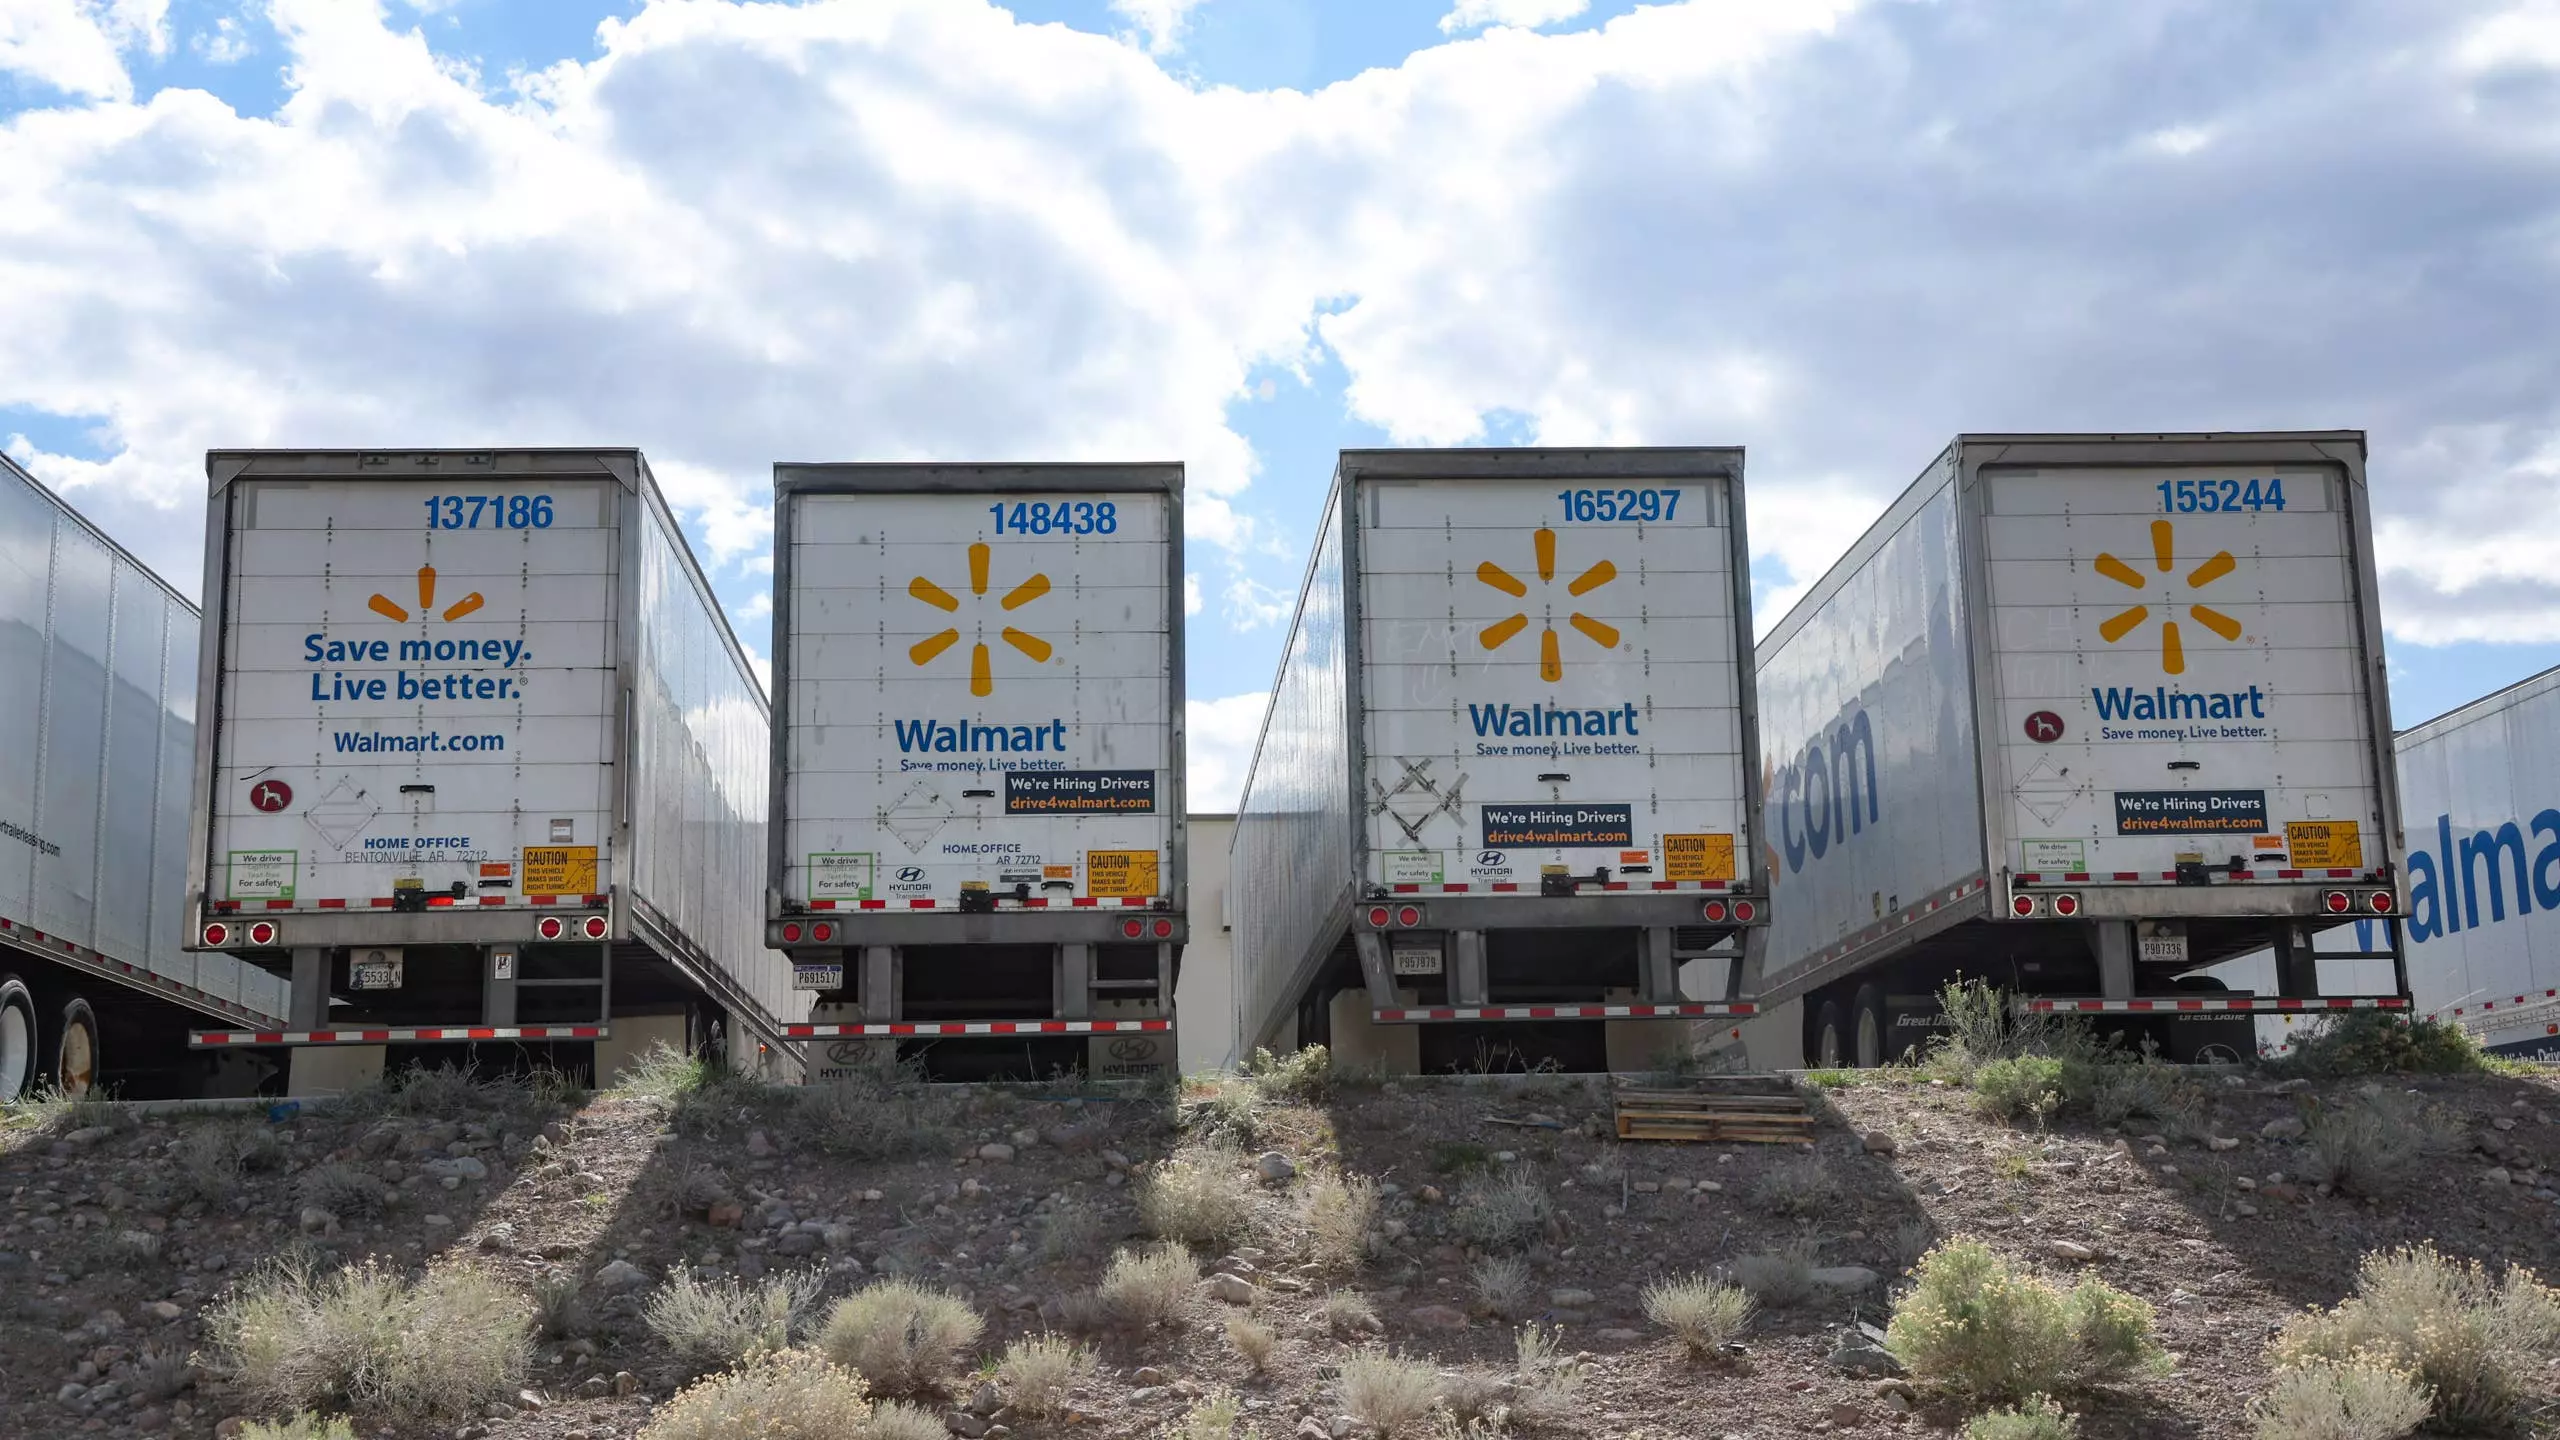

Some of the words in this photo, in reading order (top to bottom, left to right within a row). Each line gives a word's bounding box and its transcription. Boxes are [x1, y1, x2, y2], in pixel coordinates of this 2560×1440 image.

[2157, 479, 2286, 513] 155244
[424, 495, 553, 530] 137186
[1558, 489, 1681, 522] 165297
[989, 502, 1117, 535] 148438
[304, 634, 389, 663] Save
[400, 638, 532, 668] money.
[312, 672, 386, 701] Live
[397, 670, 520, 700] better.
[2091, 685, 2265, 721] Walmart
[1468, 702, 1639, 738] Walmart
[895, 718, 1067, 753] Walmart
[2102, 727, 2134, 740] Save
[2138, 728, 2187, 742] money.
[2190, 726, 2217, 738] Live
[2221, 725, 2267, 738] better.
[334, 732, 505, 753] Walmart.com
[1477, 743, 1509, 756] Save
[1512, 744, 1560, 758] money.
[1564, 743, 1590, 755] Live
[1594, 742, 1640, 755] better.
[901, 759, 933, 772] Save
[937, 760, 986, 774] money.
[989, 758, 1017, 771] Live
[1020, 758, 1066, 771] better.
[1010, 777, 1050, 791] We're
[1053, 776, 1096, 793] Hiring
[1101, 776, 1150, 790] Drivers
[1010, 796, 1150, 810] drive4walmart.com
[2120, 798, 2160, 811] We're
[2163, 797, 2207, 813] Hiring
[2211, 797, 2261, 810] Drivers
[1488, 811, 1526, 825] We're
[1530, 811, 1573, 827] Hiring
[1578, 810, 1627, 823] Drivers
[2122, 816, 2263, 830] drive4walmart.com
[1488, 829, 1628, 843] drive4walmart.com
[2291, 826, 2330, 840] CAUTION
[364, 838, 409, 849] HOME
[415, 837, 470, 849] OFFICE
[943, 844, 977, 854] HOME
[980, 844, 1021, 854] OFFICE
[1667, 839, 1706, 852] CAUTION
[260, 854, 282, 862] drive
[456, 851, 488, 861] 72712
[527, 851, 568, 866] CAUTION
[996, 856, 1010, 864] AR
[1016, 855, 1040, 865] 72712
[1091, 855, 1130, 869] CAUTION
[239, 879, 253, 887] For
[255, 878, 282, 888] safety
[819, 880, 833, 888] For
[834, 880, 860, 889] safety
[799, 972, 836, 983] P691517
[1896, 1013, 1931, 1026] Great
